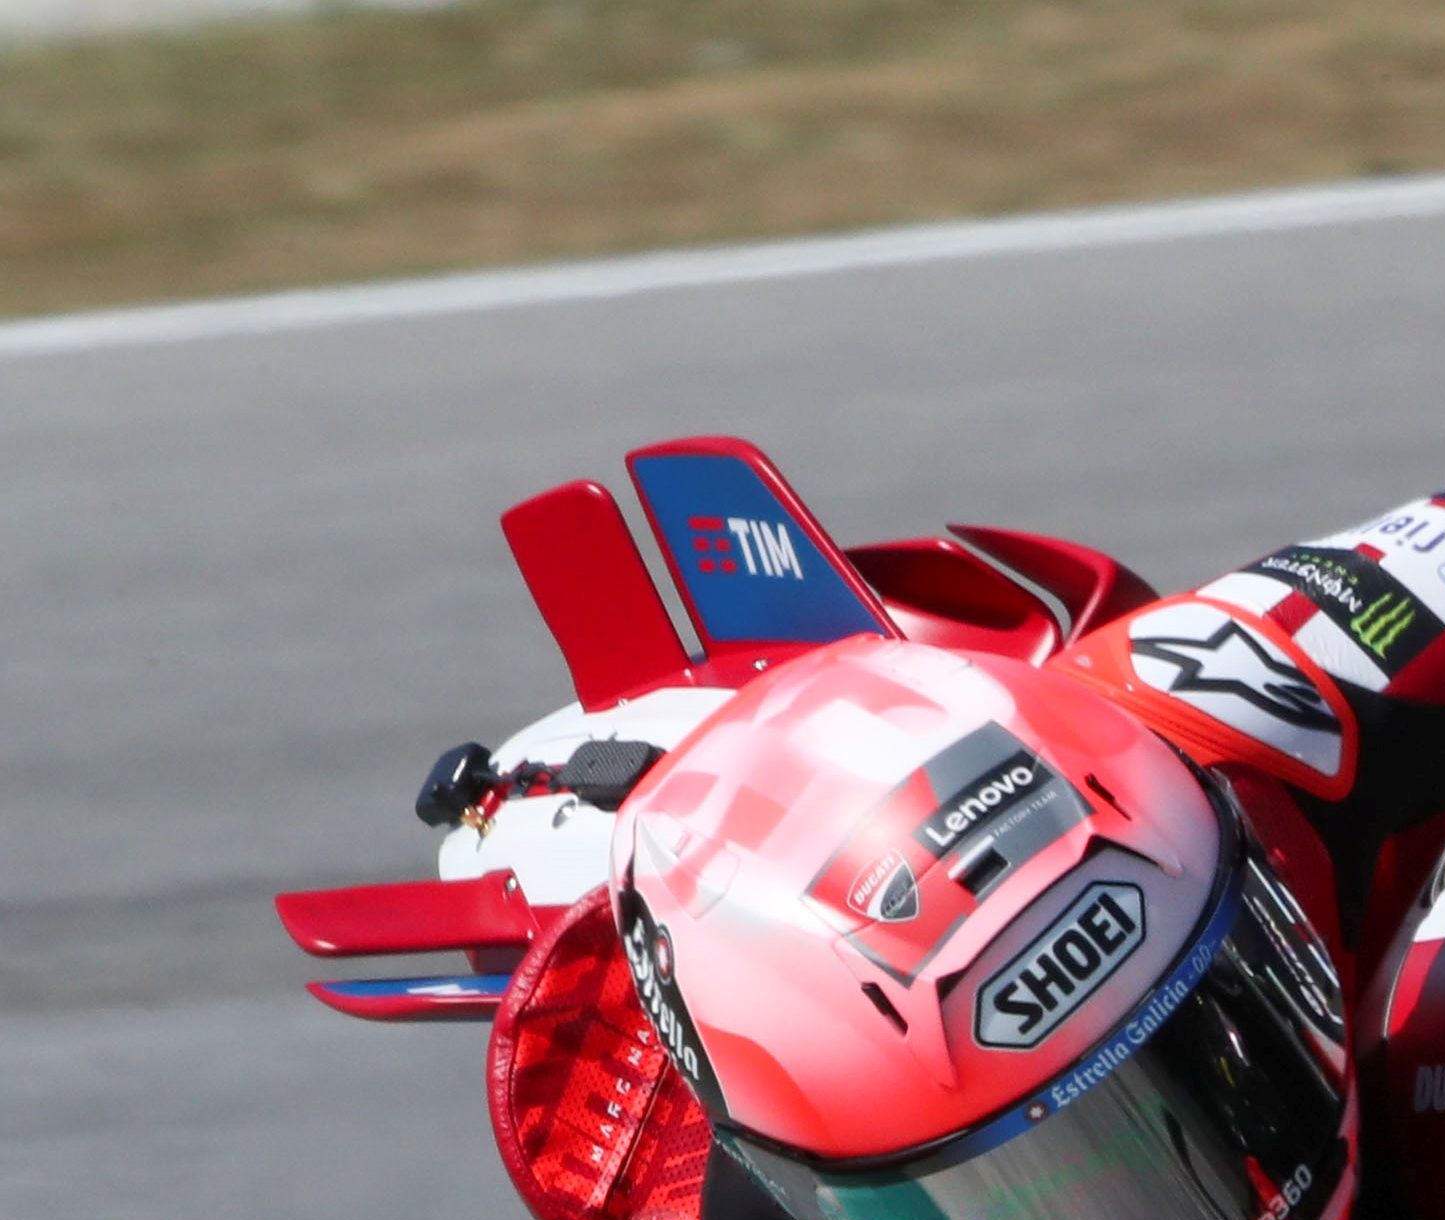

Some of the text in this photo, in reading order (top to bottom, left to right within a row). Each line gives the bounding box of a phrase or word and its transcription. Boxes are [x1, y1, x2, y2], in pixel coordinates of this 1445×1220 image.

[726, 516, 805, 580] TIM
[924, 764, 1034, 848] Lenovo
[992, 891, 1137, 1036] SHOEI
[1050, 1041, 1131, 1108] Estrella
[1125, 977, 1190, 1046] Galicia
